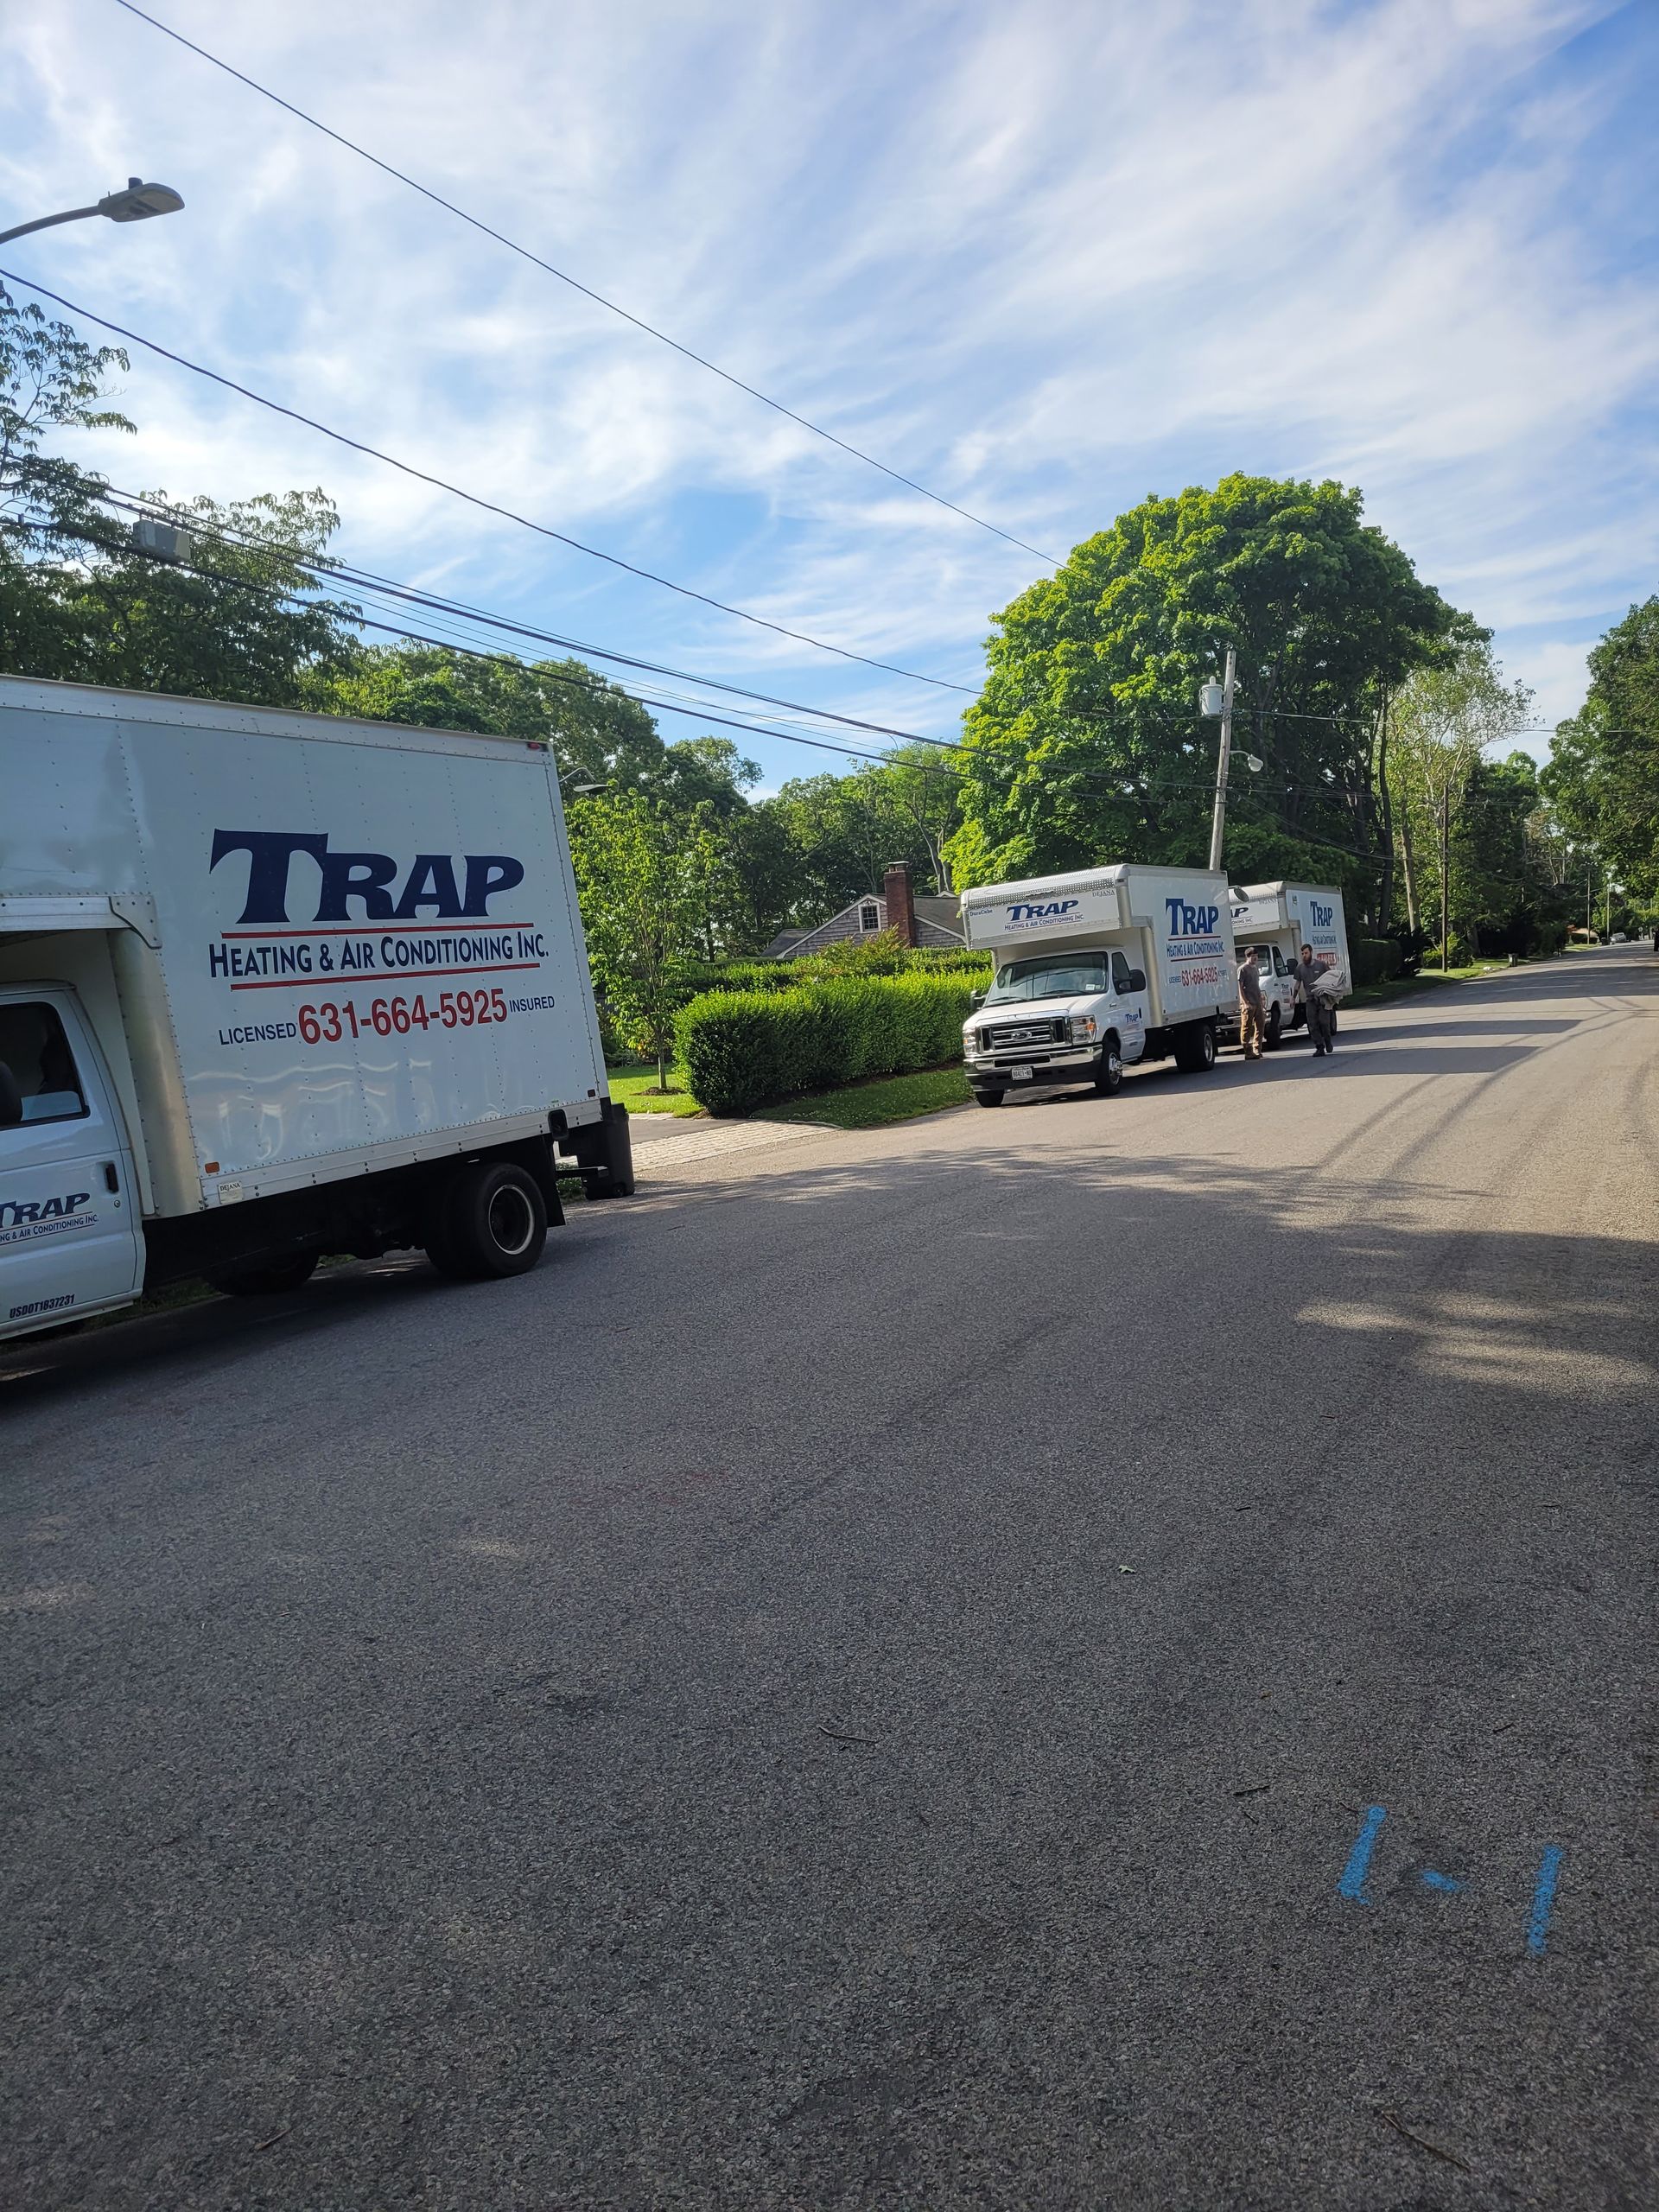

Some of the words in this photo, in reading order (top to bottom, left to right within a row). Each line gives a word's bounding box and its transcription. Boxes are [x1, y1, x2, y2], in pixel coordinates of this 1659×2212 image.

[209, 829, 524, 924] TRAP
[1006, 899, 1079, 921] TRAP
[1039, 916, 1074, 925] CONDITIONING
[1166, 898, 1219, 936] TRAP
[1310, 901, 1332, 926] TRAP
[209, 943, 313, 977] HEATING
[319, 944, 334, 971] &
[340, 938, 376, 970] AIR
[380, 936, 513, 968] CONDITIONING
[517, 931, 550, 958] INC.
[1181, 966, 1218, 987] 631-664-5925
[219, 1022, 297, 1046] LICENSED
[298, 988, 508, 1045] 631-664-5925
[509, 995, 556, 1013] INSURED
[219, 1182, 241, 1192] DEJANA
[19, 1229, 31, 1238] AIR
[33, 1217, 84, 1235] CONDITIONING
[10, 1293, 75, 1319] USDOT1837231
